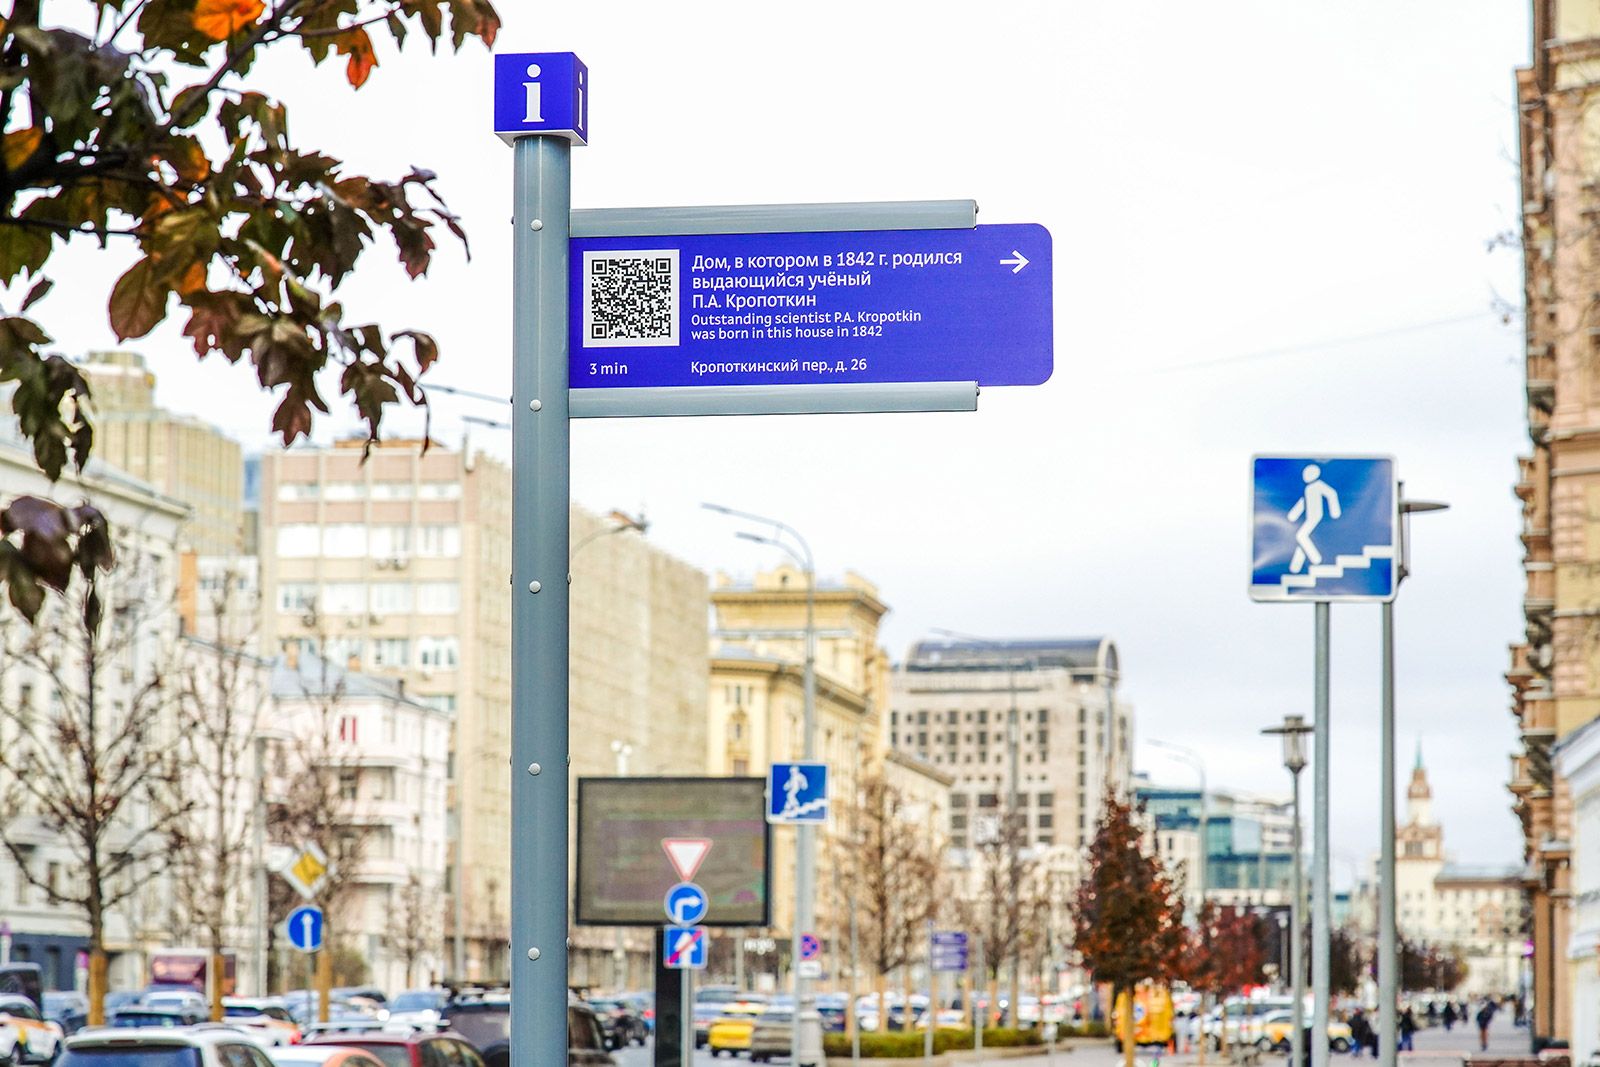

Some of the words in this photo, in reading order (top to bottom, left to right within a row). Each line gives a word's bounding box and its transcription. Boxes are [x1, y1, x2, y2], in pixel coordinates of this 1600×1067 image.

[692, 256, 732, 273] Дом,
[735, 257, 744, 269] в
[749, 255, 819, 271] котором
[824, 254, 833, 266] в
[837, 252, 875, 267] 1842
[880, 253, 889, 266] г.
[893, 252, 962, 270] родился
[692, 273, 804, 291] выдающийся
[808, 271, 871, 290] учёный
[692, 294, 722, 308] П.А.
[727, 293, 817, 311] Кропоткин
[691, 313, 772, 327] Outstanding
[775, 312, 832, 324] scientist
[834, 312, 855, 323] P.A.
[858, 310, 922, 326] Kropotkin
[691, 328, 716, 339] was
[719, 328, 749, 339] born
[752, 327, 764, 338] in
[767, 327, 793, 338] this
[796, 327, 834, 338] house
[837, 326, 849, 337] in
[853, 325, 882, 337] 1842
[590, 363, 597, 375] 3
[600, 362, 628, 375] min
[691, 358, 799, 376] Кропоткинский
[851, 358, 868, 371] 26
